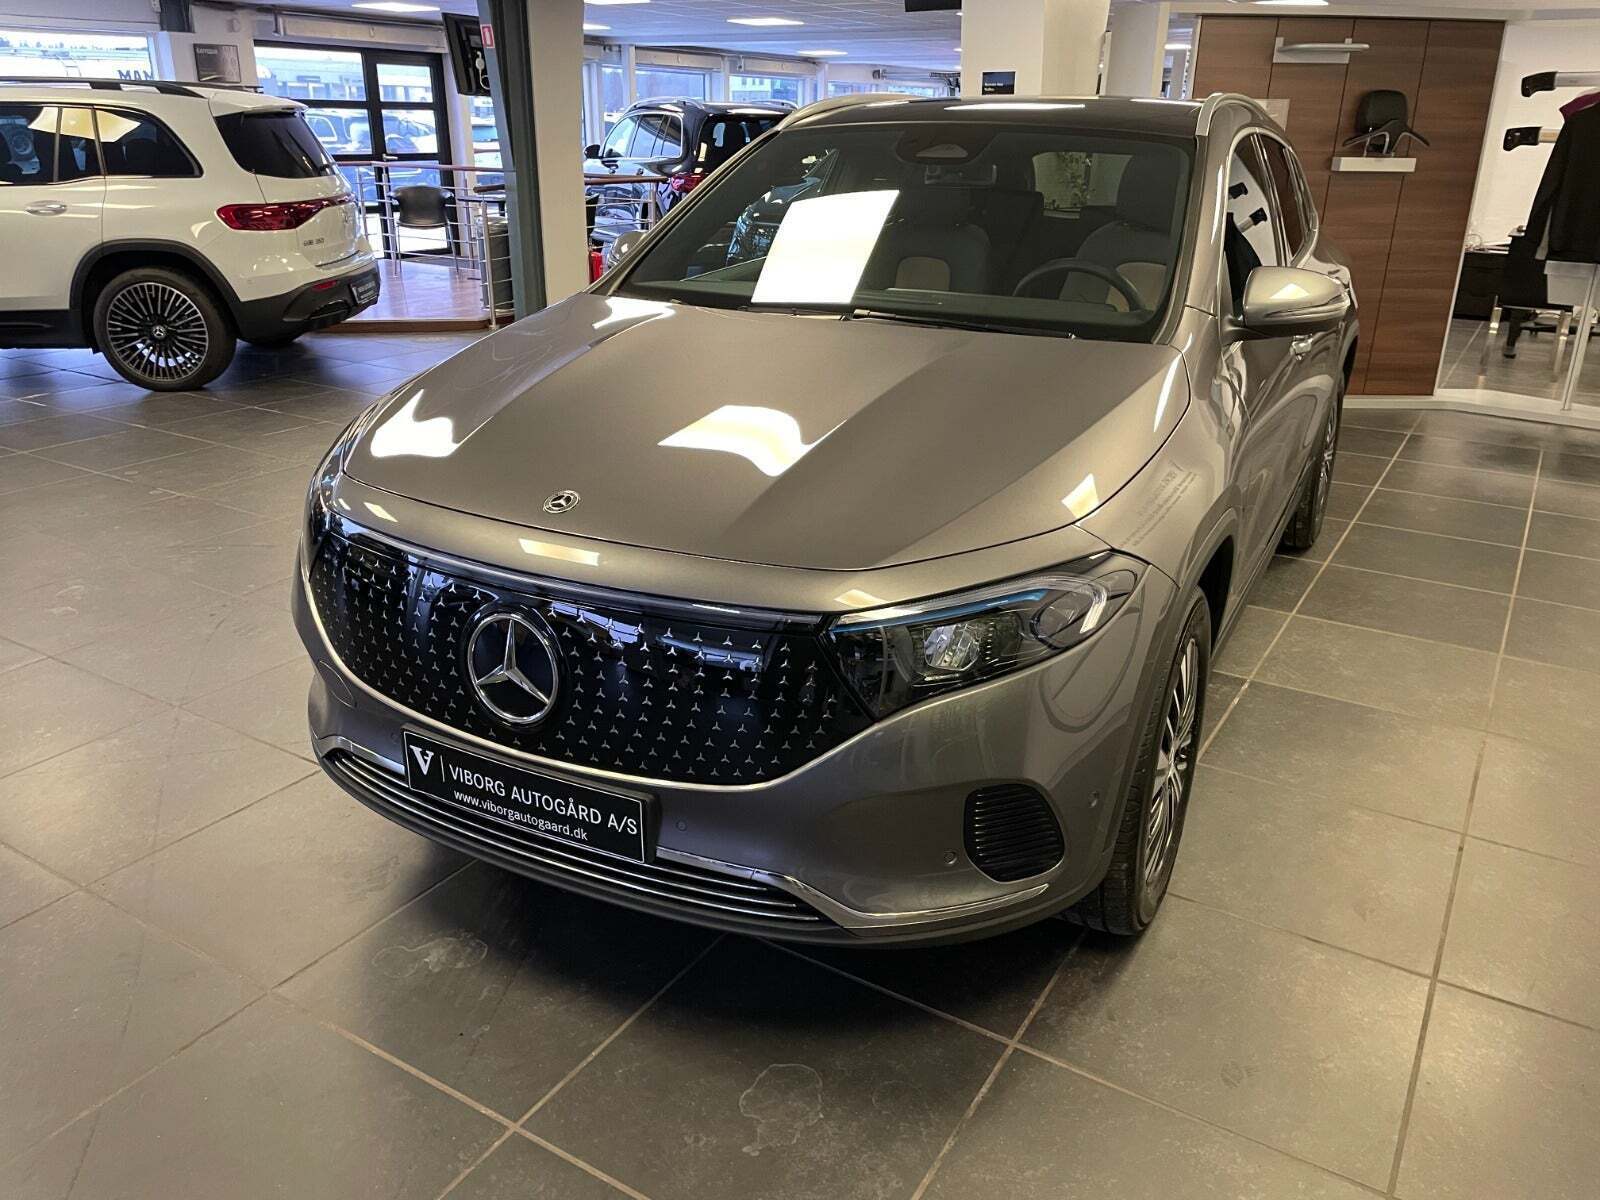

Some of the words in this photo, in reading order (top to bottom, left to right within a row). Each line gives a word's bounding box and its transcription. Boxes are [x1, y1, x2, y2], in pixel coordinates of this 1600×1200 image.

[449, 764, 506, 796] VIBORG
[511, 786, 602, 825] AUTOGÅRD
[607, 813, 638, 835] A/S
[453, 789, 588, 841] www.viborgautogaard.dk
